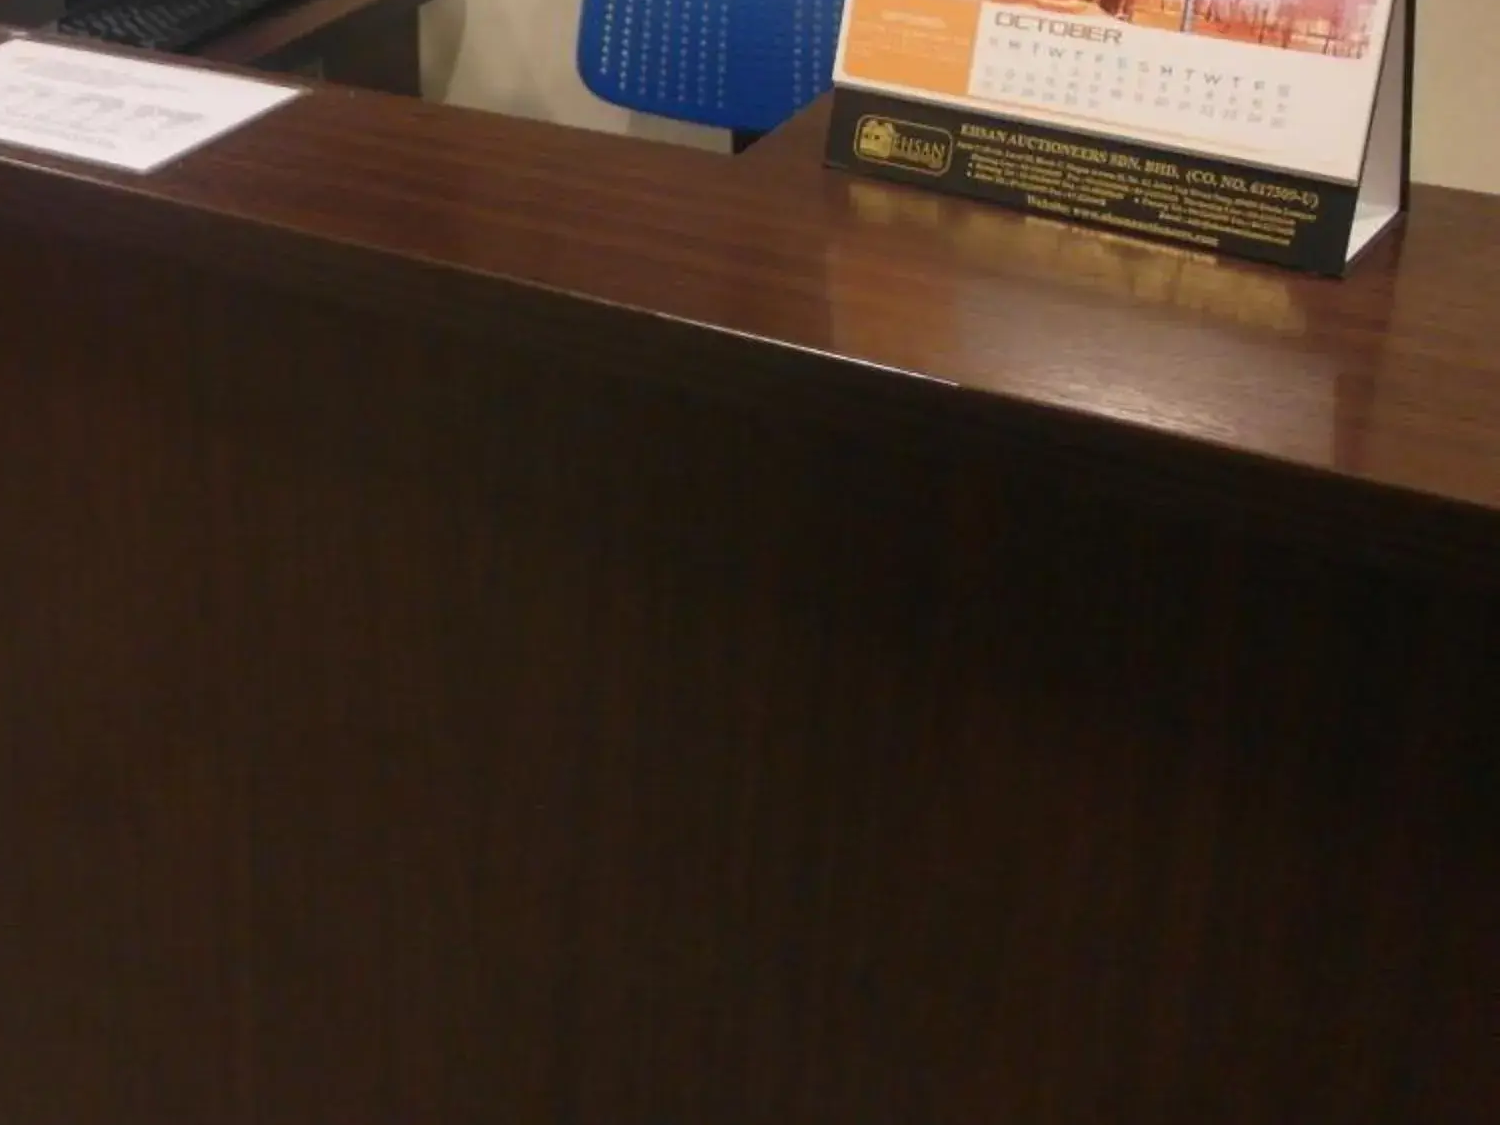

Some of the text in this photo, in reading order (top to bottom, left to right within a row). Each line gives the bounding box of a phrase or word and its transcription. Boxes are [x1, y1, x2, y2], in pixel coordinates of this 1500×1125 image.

[994, 10, 1123, 44] OCTOBER
[895, 133, 946, 166] EHSAN
[960, 123, 1008, 144] EHSAN
[1006, 131, 1108, 164] AUCTIONEERS
